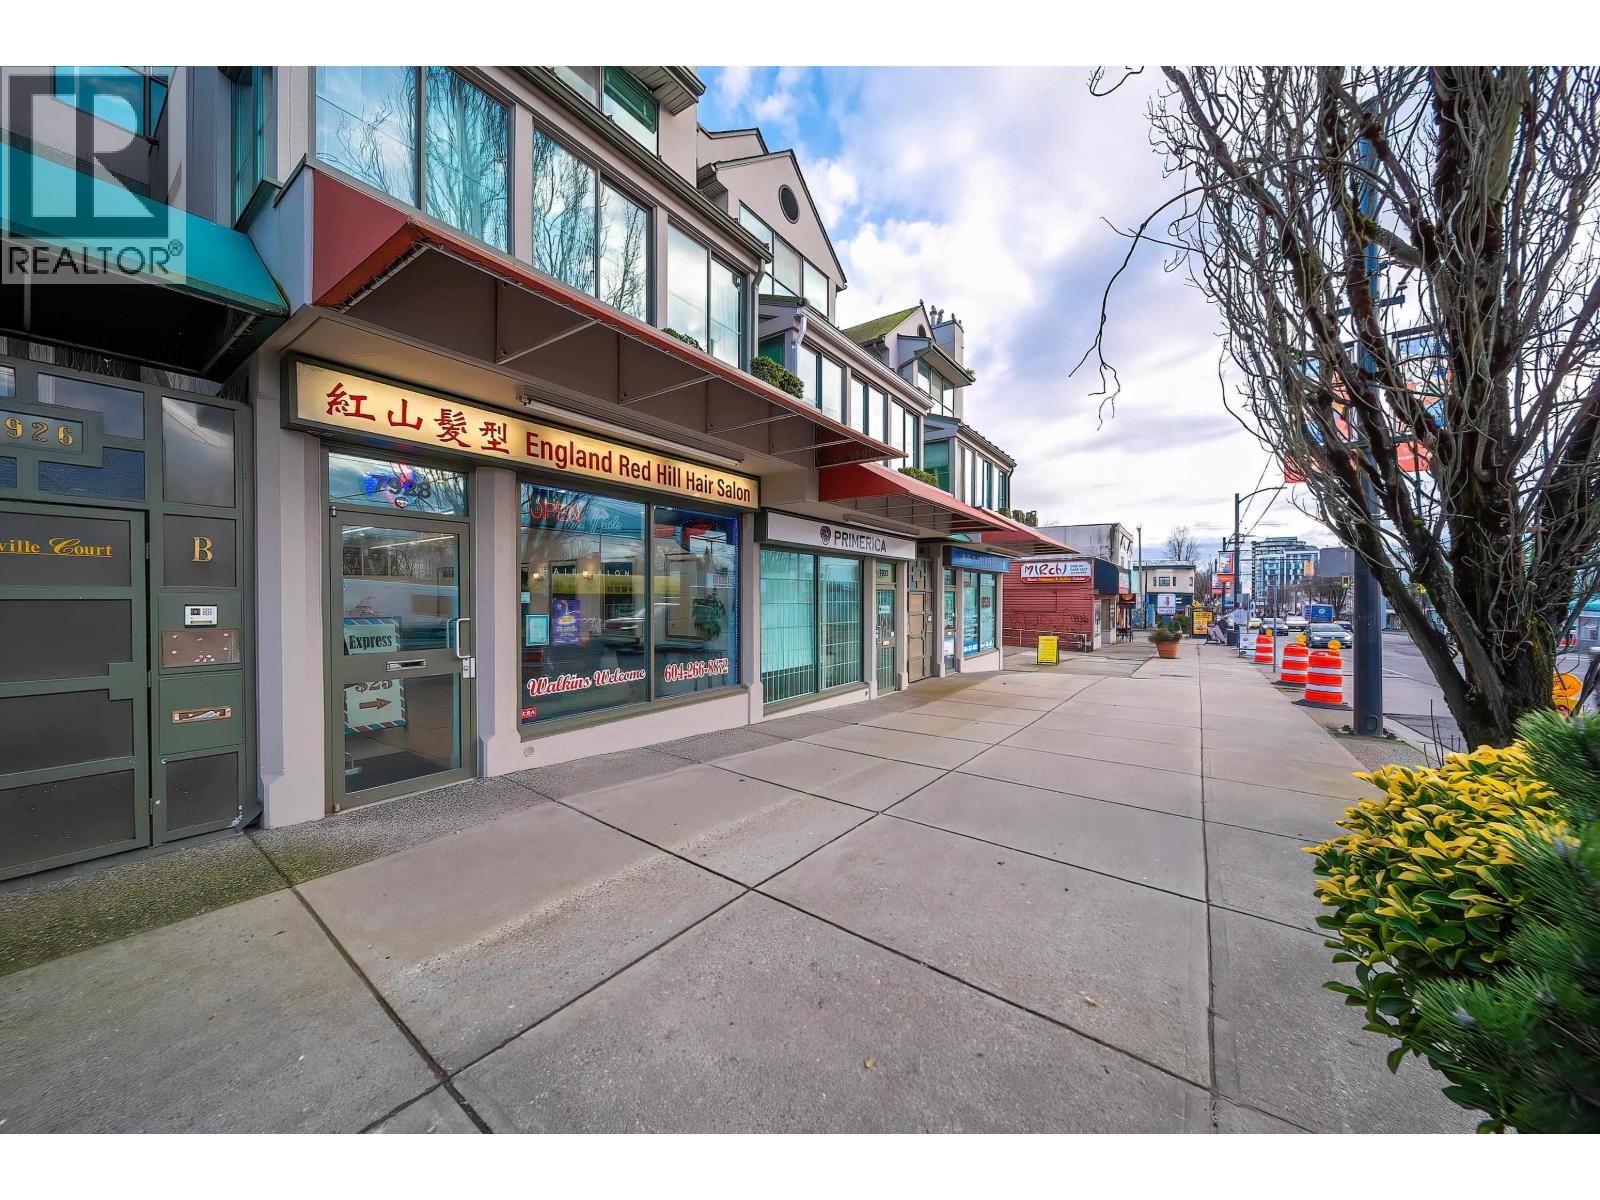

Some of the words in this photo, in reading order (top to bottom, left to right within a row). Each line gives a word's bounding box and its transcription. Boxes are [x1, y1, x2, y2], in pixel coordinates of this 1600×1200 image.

[326, 382, 510, 454] 紅山髮型
[526, 431, 612, 469] England
[619, 454, 651, 481] Red
[657, 463, 681, 488] Hill
[686, 470, 713, 495] Hair
[717, 478, 751, 502] Salon
[371, 474, 432, 499] 7928
[49, 537, 113, 557] Court
[192, 536, 214, 562] B
[834, 530, 887, 552] PRIMERICA
[348, 635, 393, 650] Express
[527, 673, 593, 696] Walkins
[594, 668, 647, 687] Welcome
[663, 657, 729, 682] 604-266-8872
